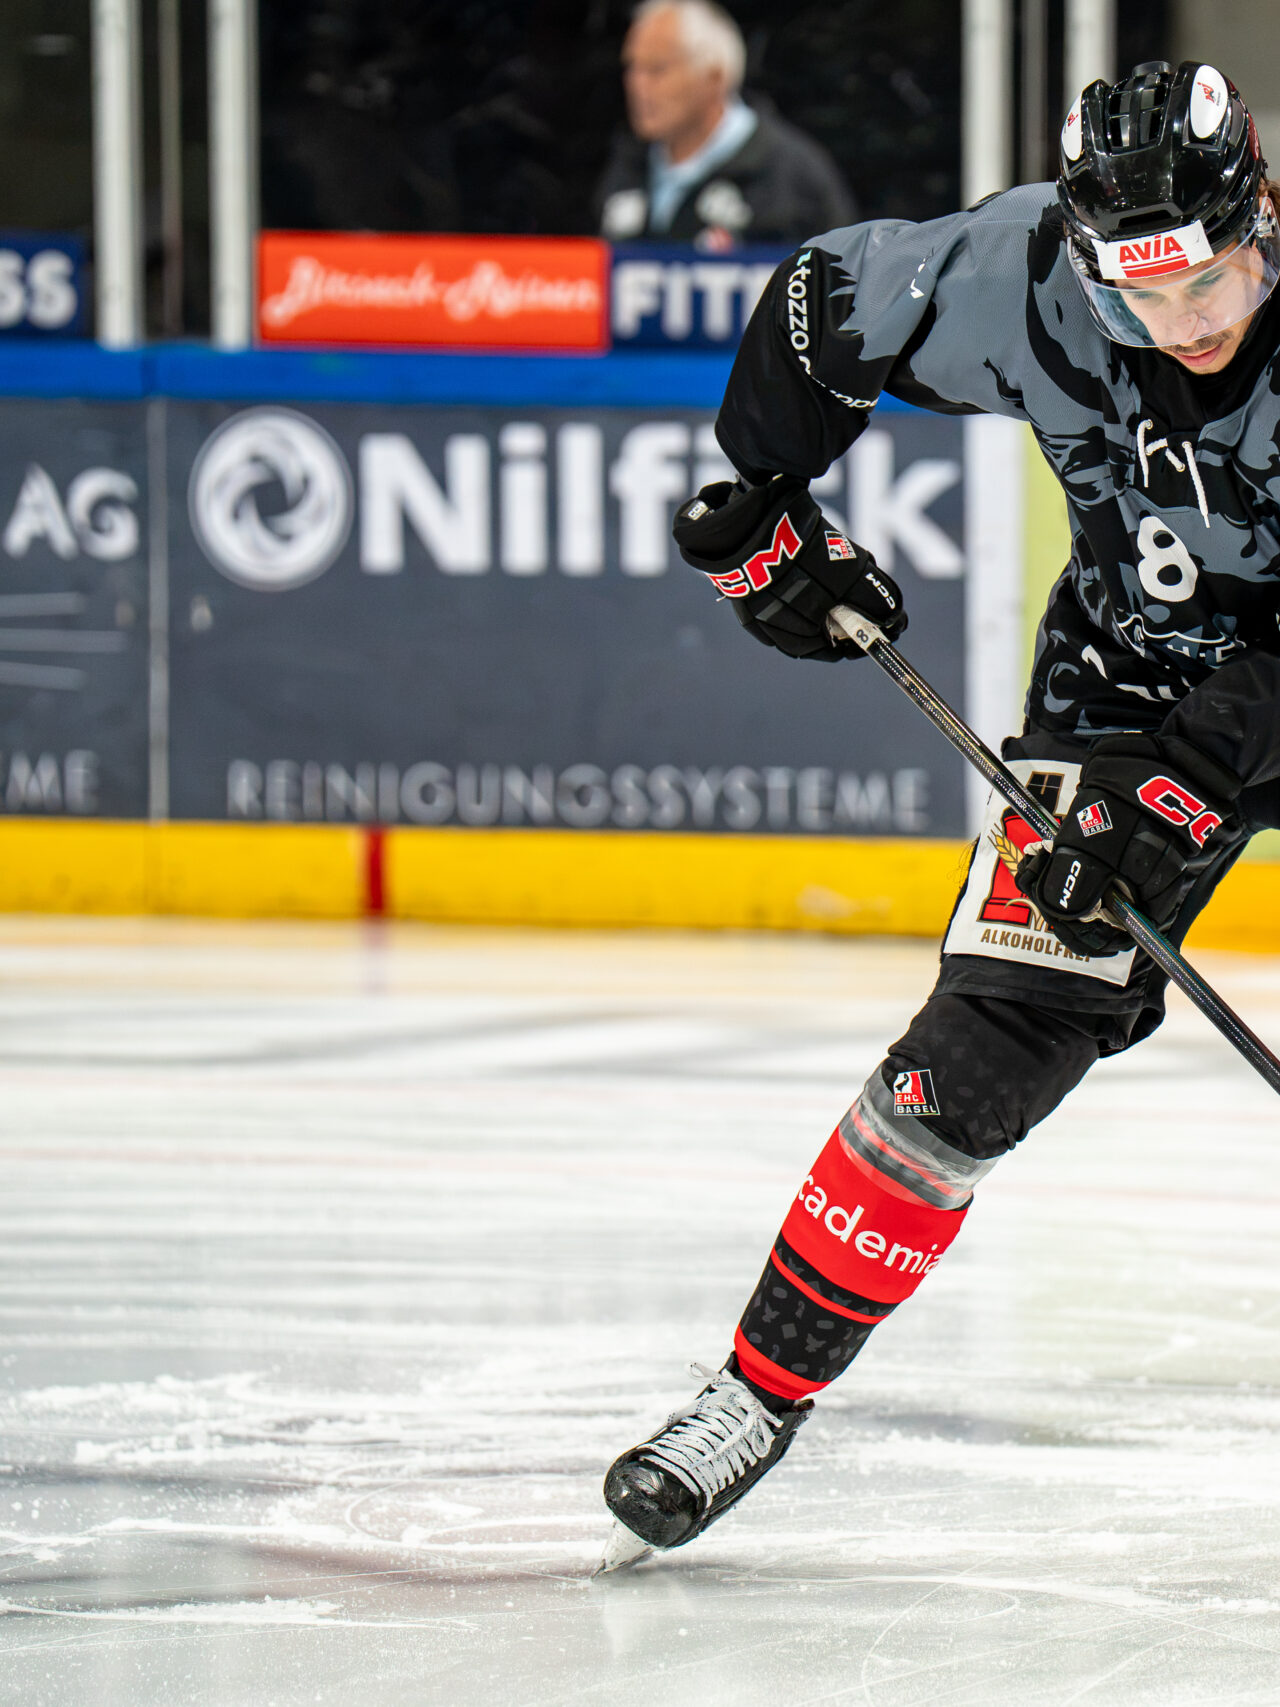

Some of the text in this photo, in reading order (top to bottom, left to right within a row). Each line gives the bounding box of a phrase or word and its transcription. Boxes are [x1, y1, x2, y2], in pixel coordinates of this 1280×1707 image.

[3, 460, 140, 562] AG
[358, 421, 967, 580] Nilfk
[1137, 515, 1199, 602] 8
[865, 572, 896, 610] CCM
[856, 629, 869, 643] 8
[227, 758, 931, 833] REINIGUNGSSYSTEME
[1059, 860, 1082, 909] CCM
[896, 1094, 919, 1103] EHC
[896, 1105, 937, 1114] BASEL
